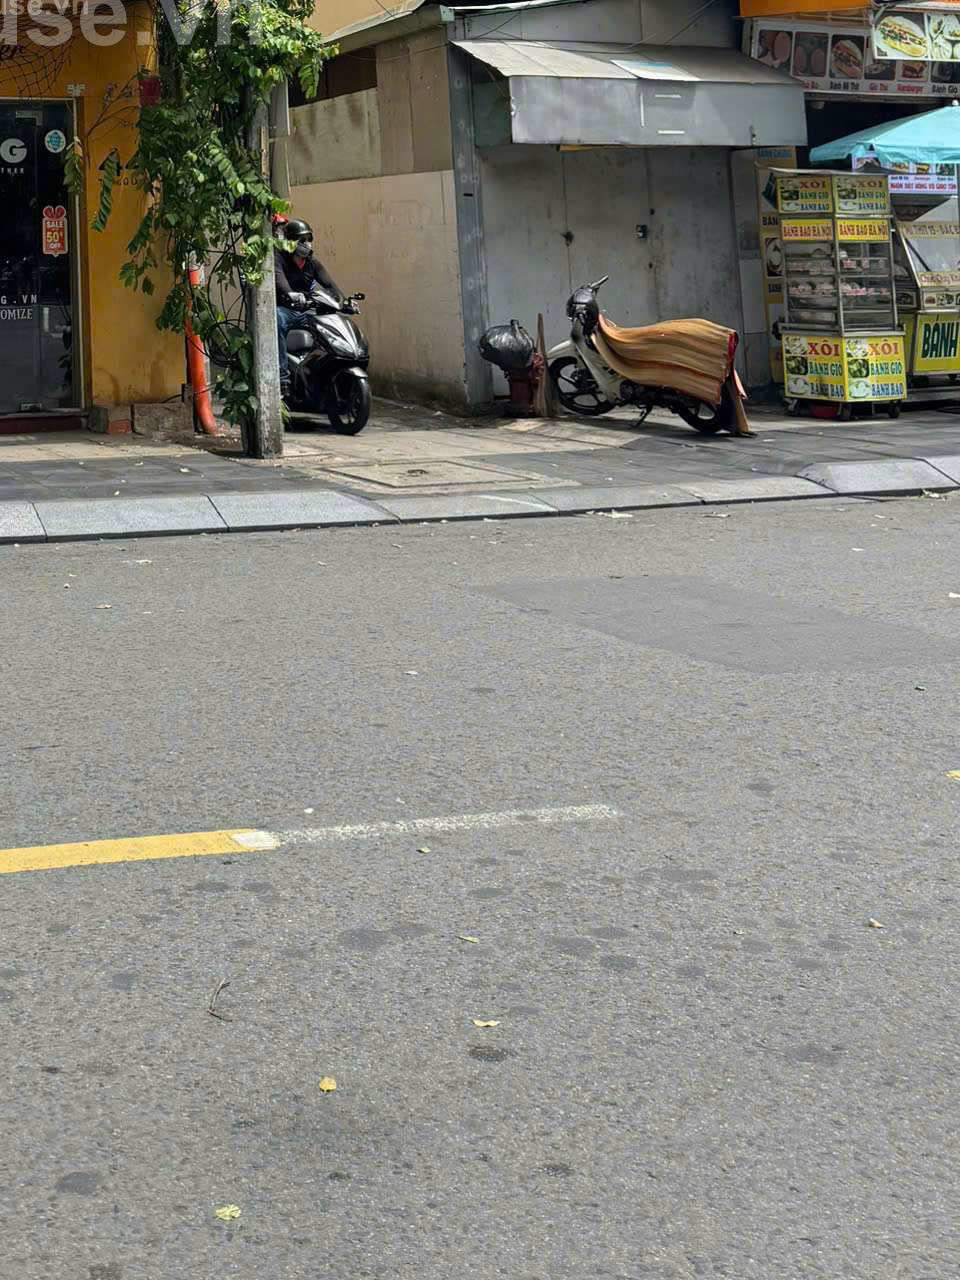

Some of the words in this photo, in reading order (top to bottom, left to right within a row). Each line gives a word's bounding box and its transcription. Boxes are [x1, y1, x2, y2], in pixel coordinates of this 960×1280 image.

[46, 221, 64, 229] SALE
[808, 339, 840, 357] XÔI
[868, 338, 899, 356] XÔI
